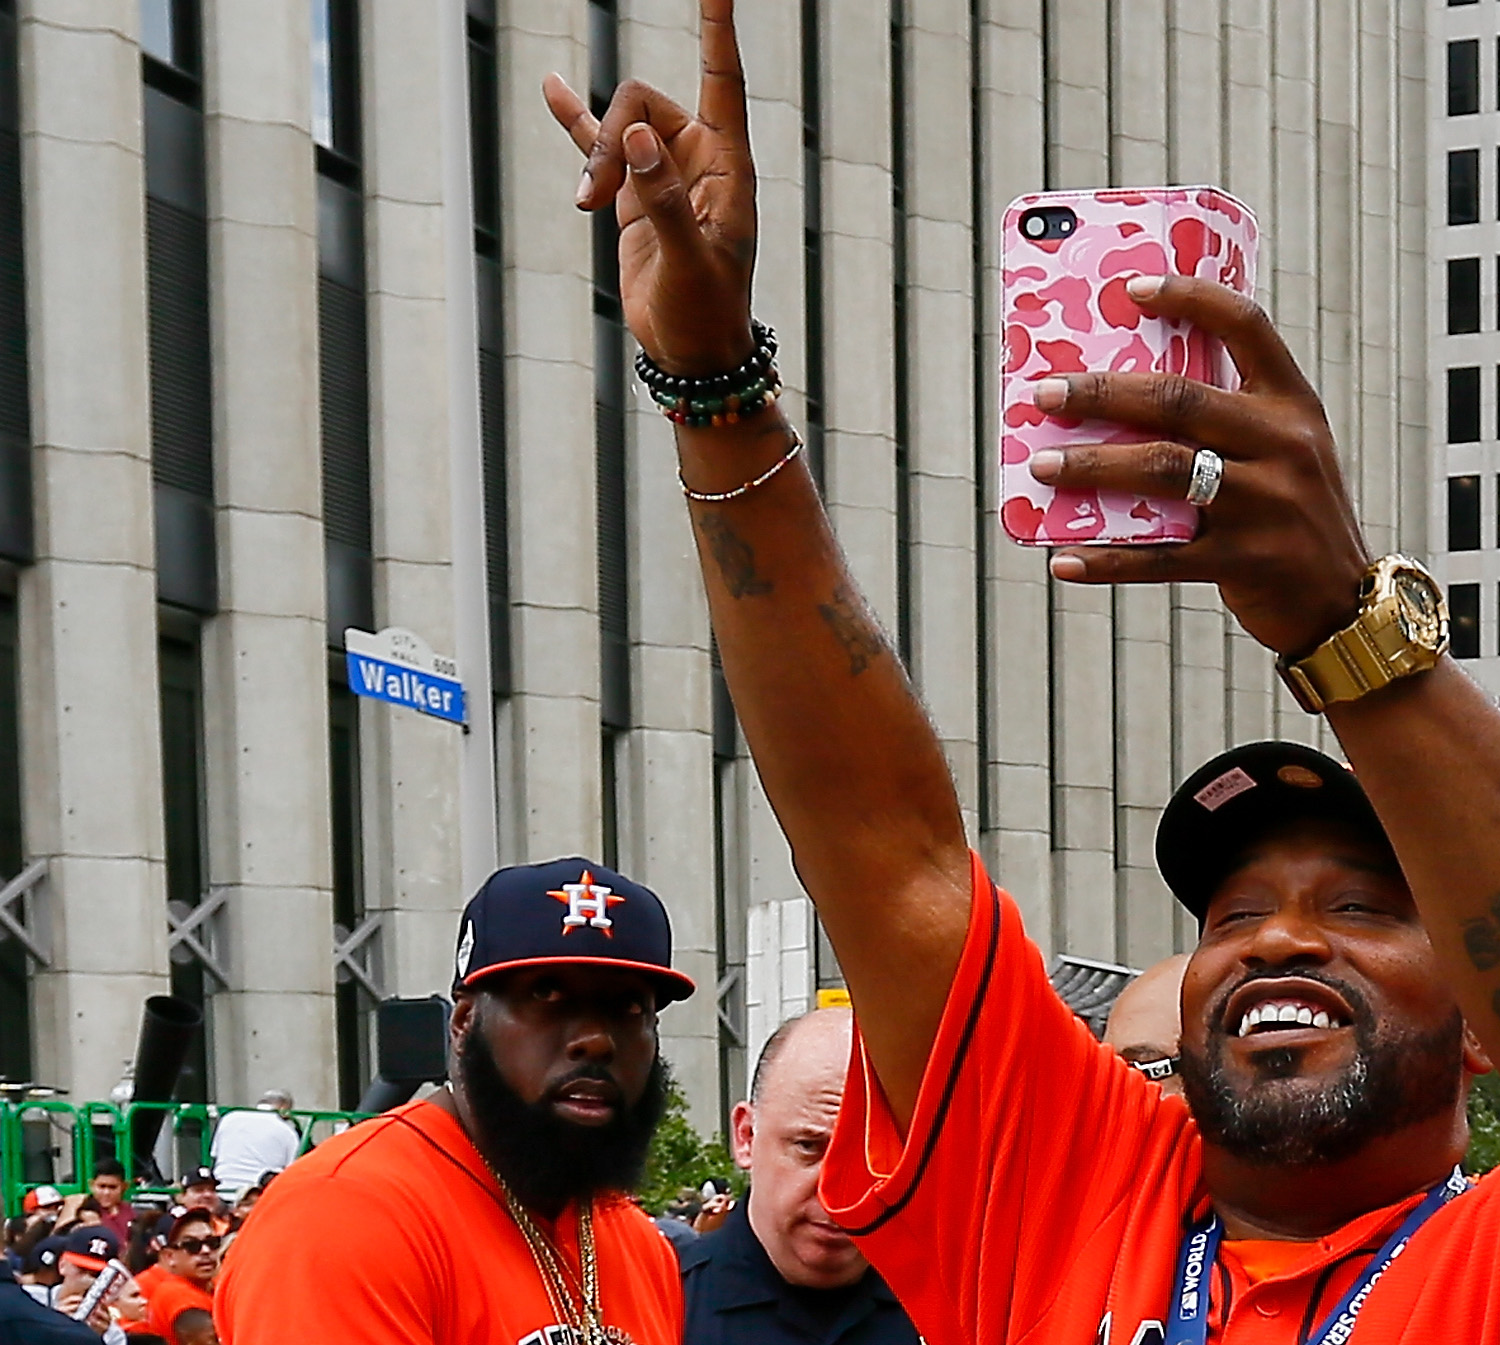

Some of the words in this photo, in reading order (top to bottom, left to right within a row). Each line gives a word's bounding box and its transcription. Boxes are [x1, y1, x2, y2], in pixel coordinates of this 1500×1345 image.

[359, 660, 453, 713] Walker
[562, 883, 613, 928] H
[1183, 1231, 1207, 1294] WORLD
